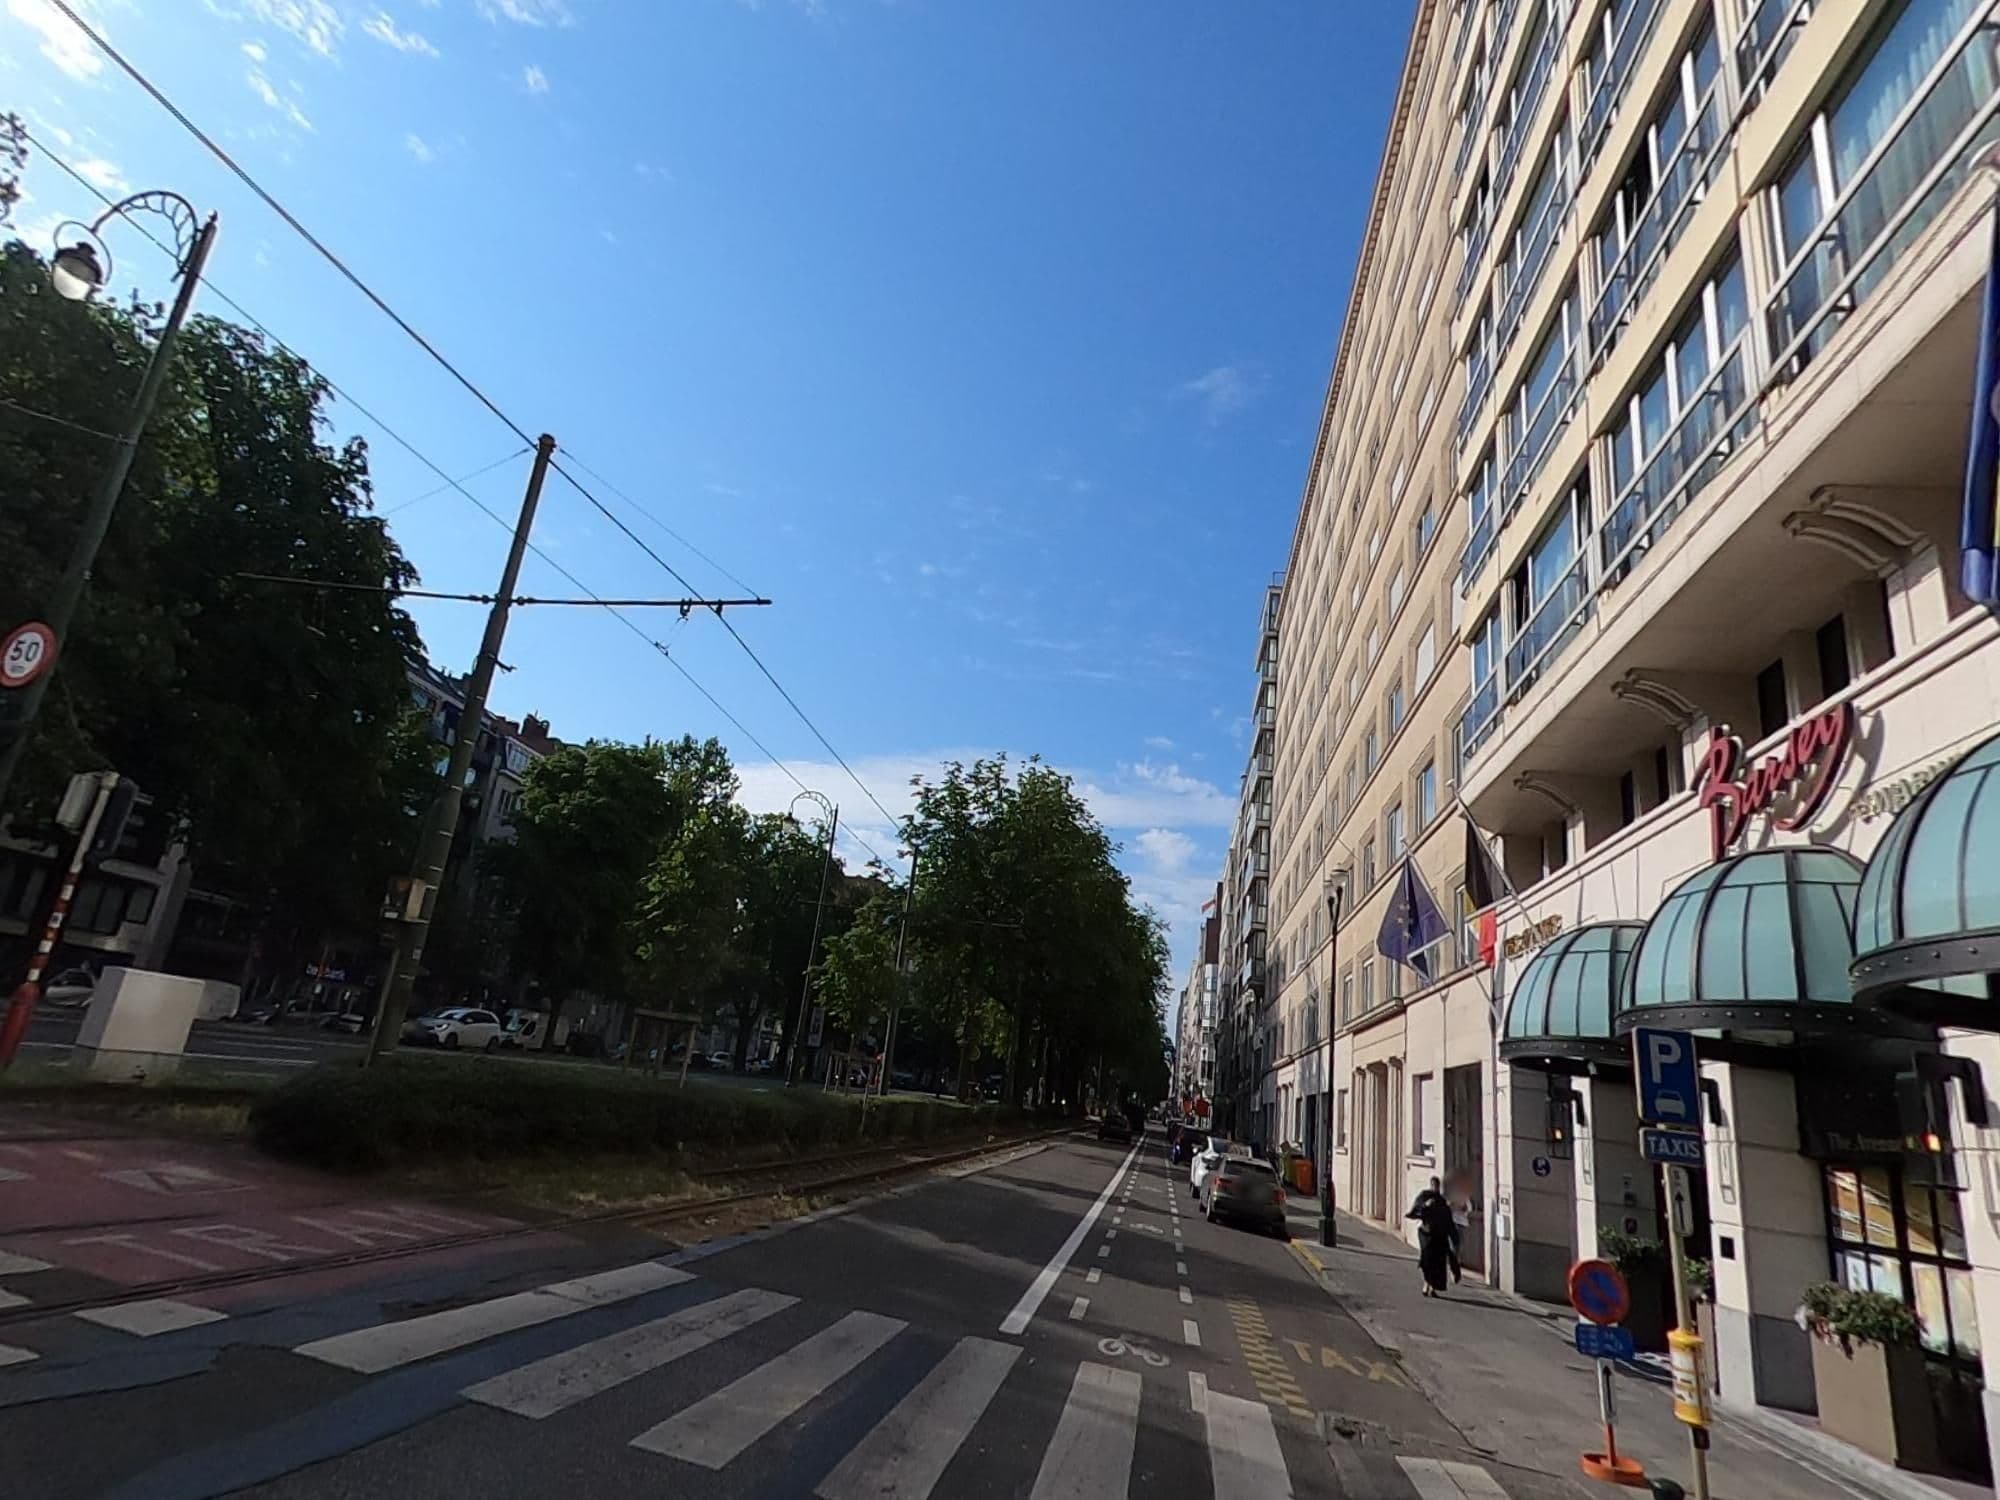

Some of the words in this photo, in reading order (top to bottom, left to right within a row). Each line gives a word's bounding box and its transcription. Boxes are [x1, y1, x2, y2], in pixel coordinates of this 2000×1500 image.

[10, 639, 41, 662] 50
[1694, 702, 1850, 862] Barsey
[1649, 1034, 1681, 1084] P
[1647, 1136, 1701, 1160] TAXIS
